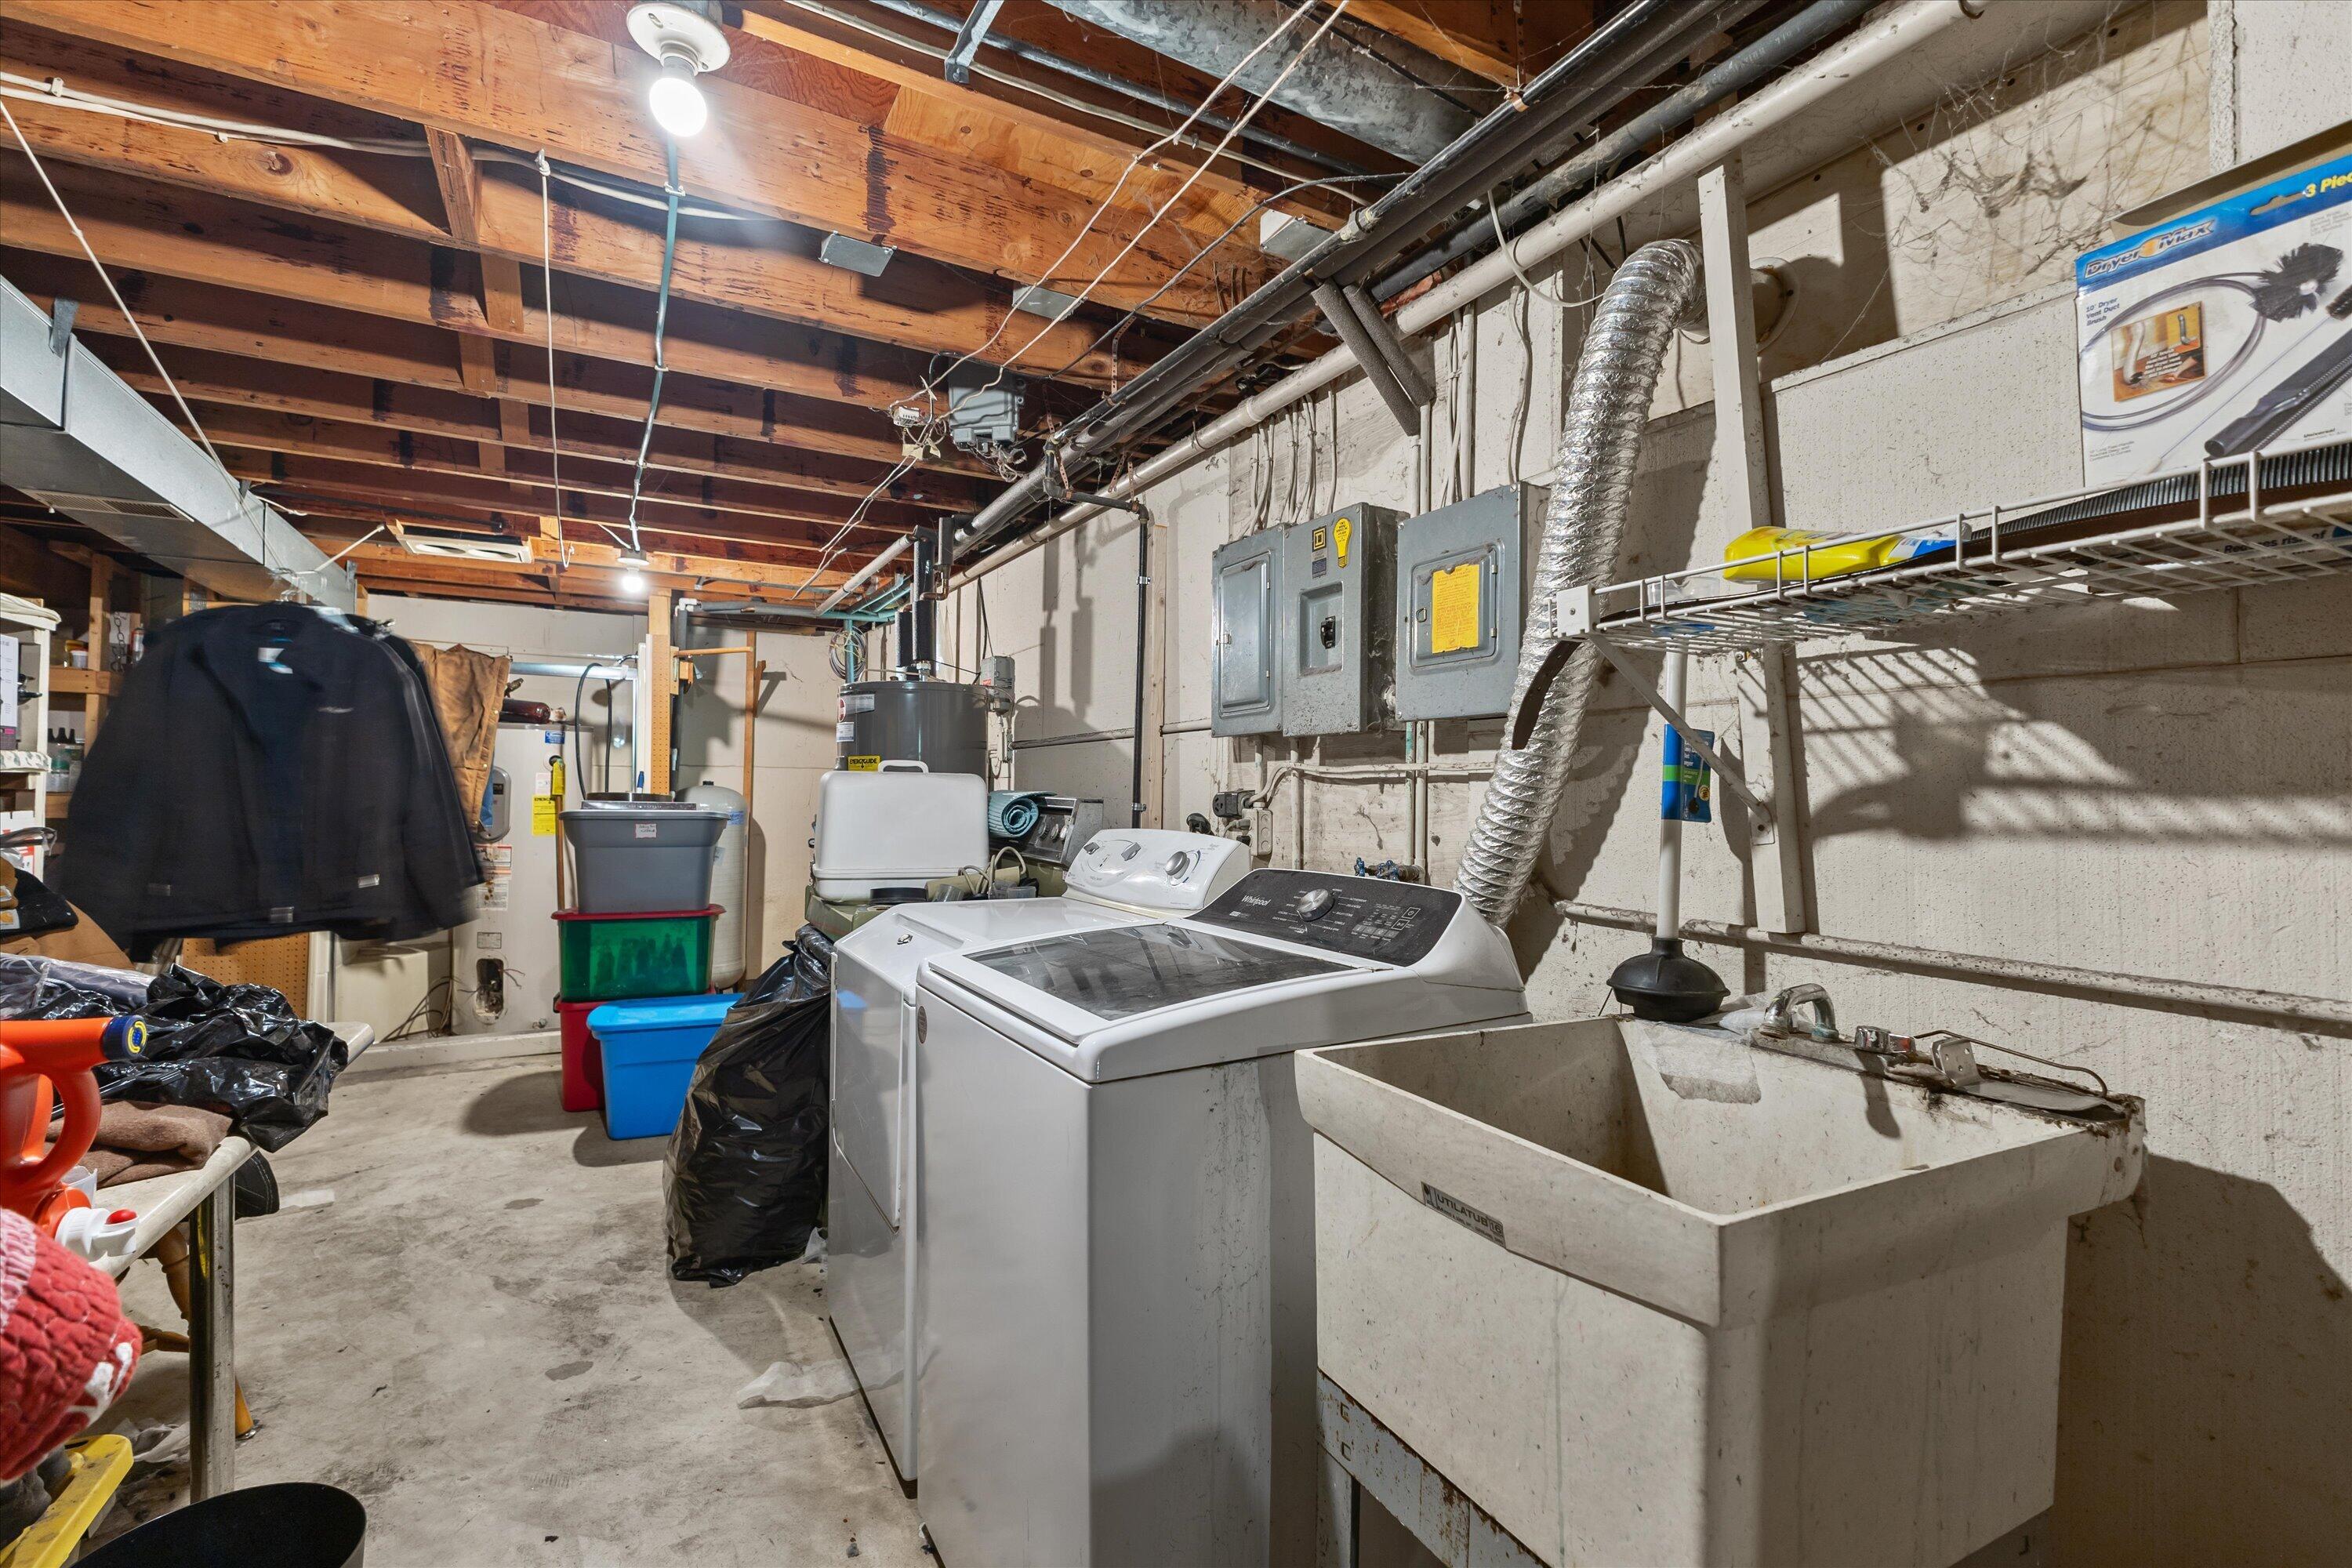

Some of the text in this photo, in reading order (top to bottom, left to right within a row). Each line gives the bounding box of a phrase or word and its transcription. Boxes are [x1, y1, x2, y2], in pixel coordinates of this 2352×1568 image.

[2304, 183, 2317, 198] 3
[2085, 219, 2216, 278] Dryer Max
[2098, 297, 2118, 308] Dryer
[2086, 303, 2120, 319] Vent Duct
[2086, 315, 2107, 326] Brush
[1241, 895, 1272, 906] Whirlpool
[1436, 1193, 1489, 1228] UTILATUB
